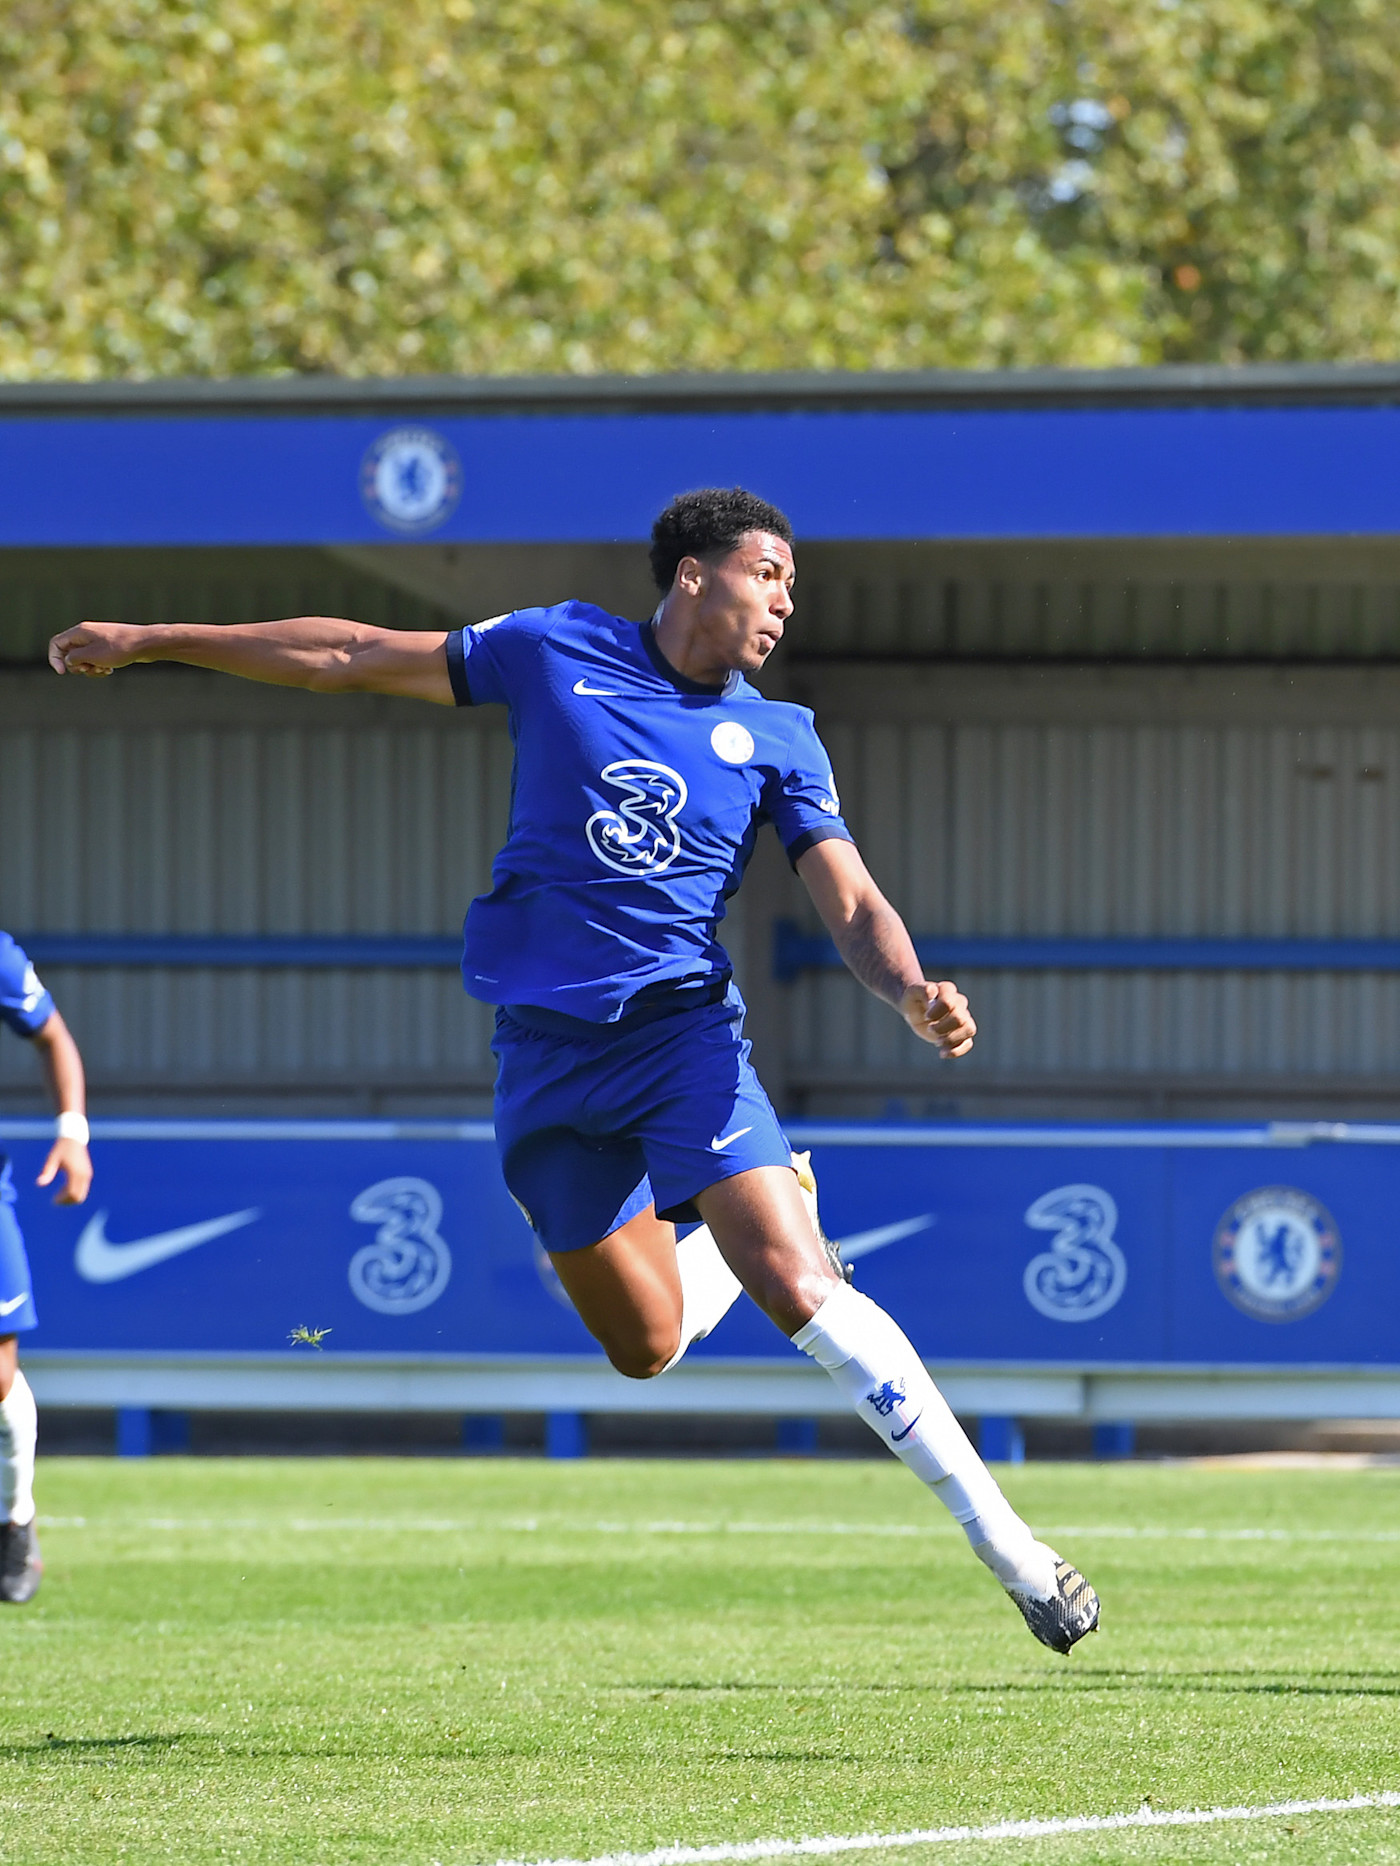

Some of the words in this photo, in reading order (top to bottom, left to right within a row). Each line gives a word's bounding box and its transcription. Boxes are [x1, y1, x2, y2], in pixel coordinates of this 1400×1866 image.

[585, 759, 689, 876] 3
[347, 1176, 452, 1315] 3
[1023, 1183, 1127, 1323] 3
